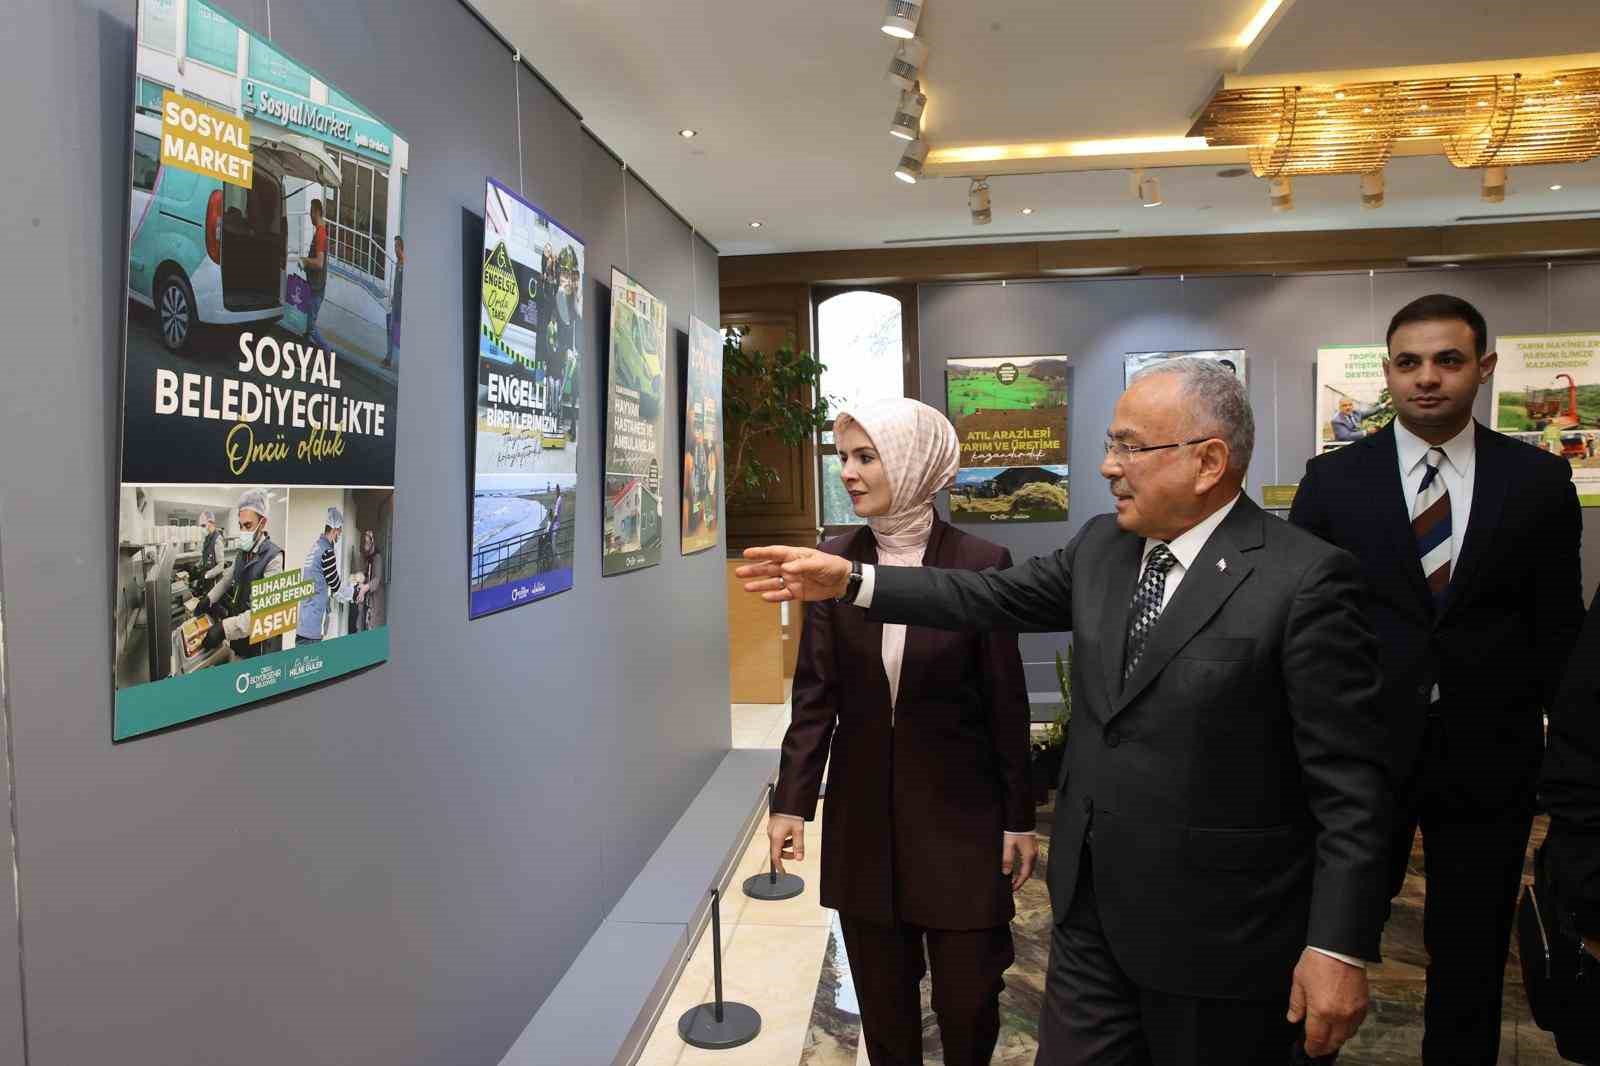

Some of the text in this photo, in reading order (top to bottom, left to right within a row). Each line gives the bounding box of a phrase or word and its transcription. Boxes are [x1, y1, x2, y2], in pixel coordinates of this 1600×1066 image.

[165, 101, 249, 150] SOSYAL
[163, 135, 251, 180] MARKET
[238, 332, 341, 389] SOSYAL
[155, 368, 385, 437] BELEDİYECİLİKTE
[297, 422, 345, 465] olduk
[960, 442, 992, 452] TARIM
[994, 441, 1009, 450] VE
[967, 427, 1051, 440] ATIL ARAZİLERİ
